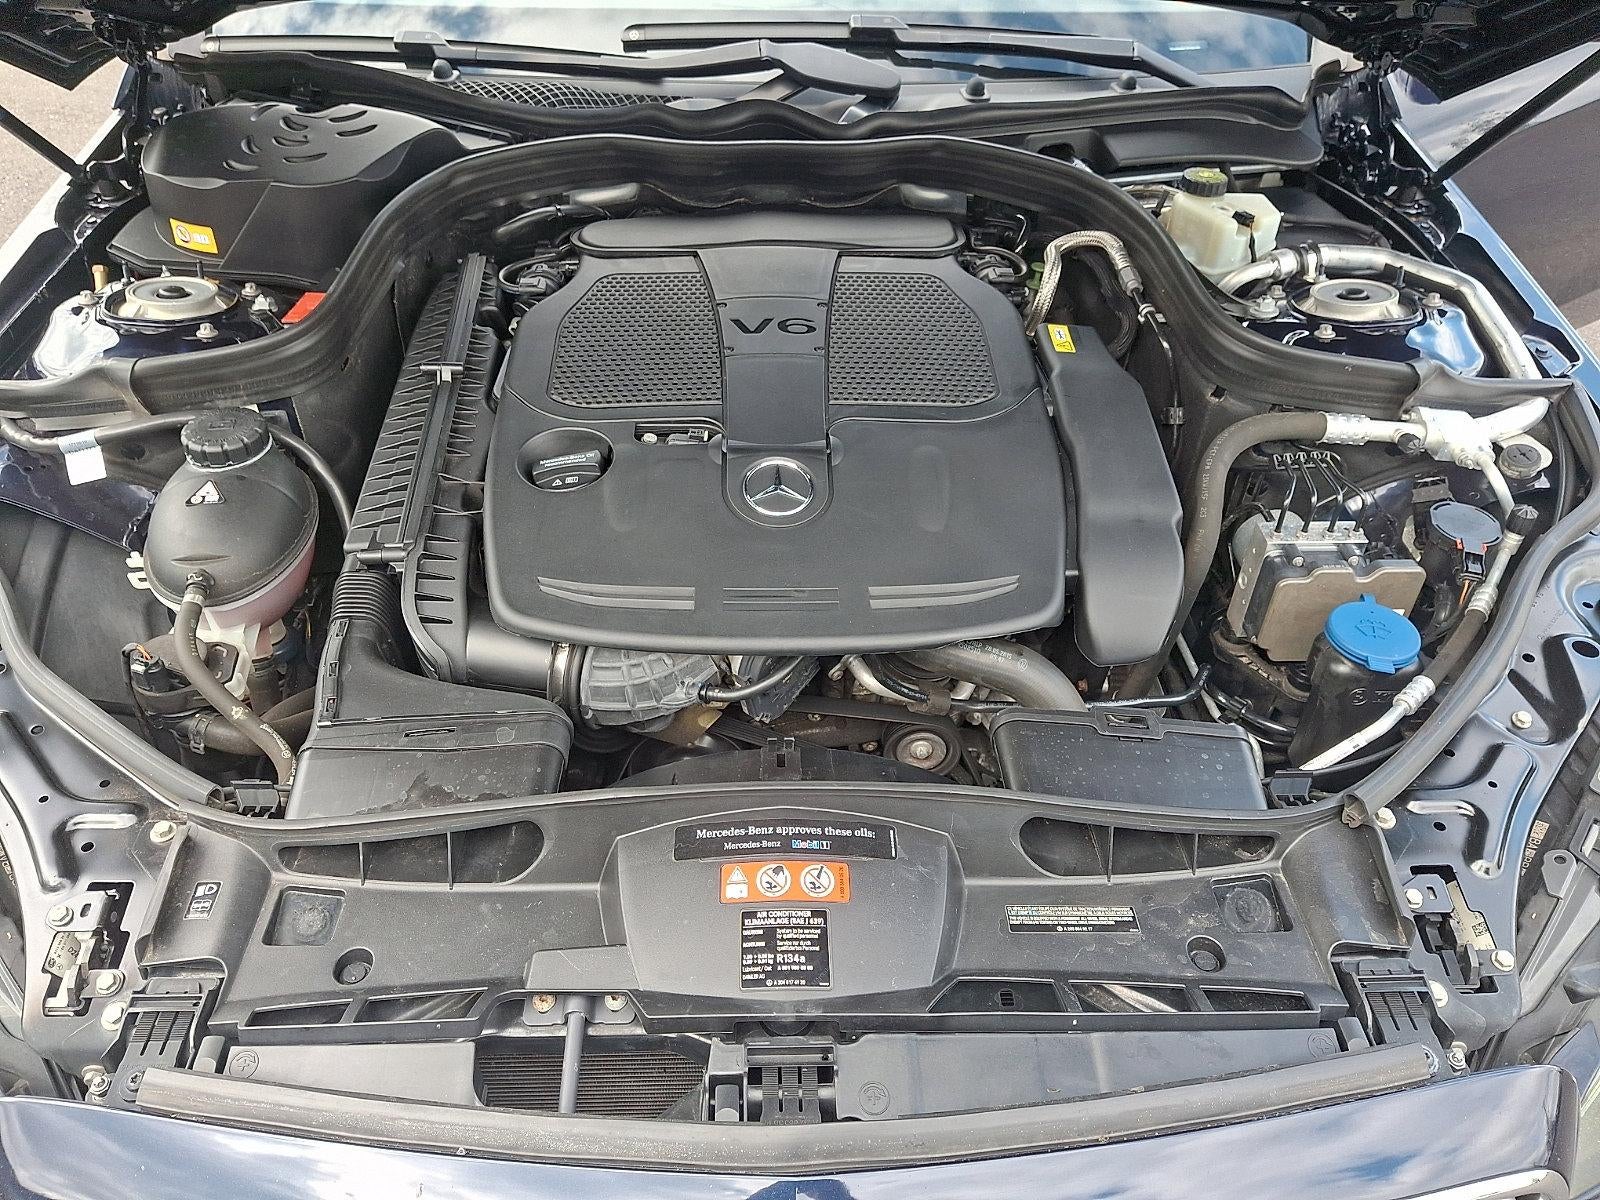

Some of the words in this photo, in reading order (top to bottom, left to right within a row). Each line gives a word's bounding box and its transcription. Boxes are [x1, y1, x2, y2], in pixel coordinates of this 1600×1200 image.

[729, 317, 817, 335] V6
[696, 825, 774, 839] Mercedes-Benz
[775, 826, 822, 836] approves
[824, 826, 853, 837] these
[854, 827, 876, 838] oils:
[723, 840, 782, 850] Mercedes-Benz
[791, 839, 820, 849] Mobil
[768, 910, 812, 918] CONDITIONER
[776, 953, 806, 964] R134a
